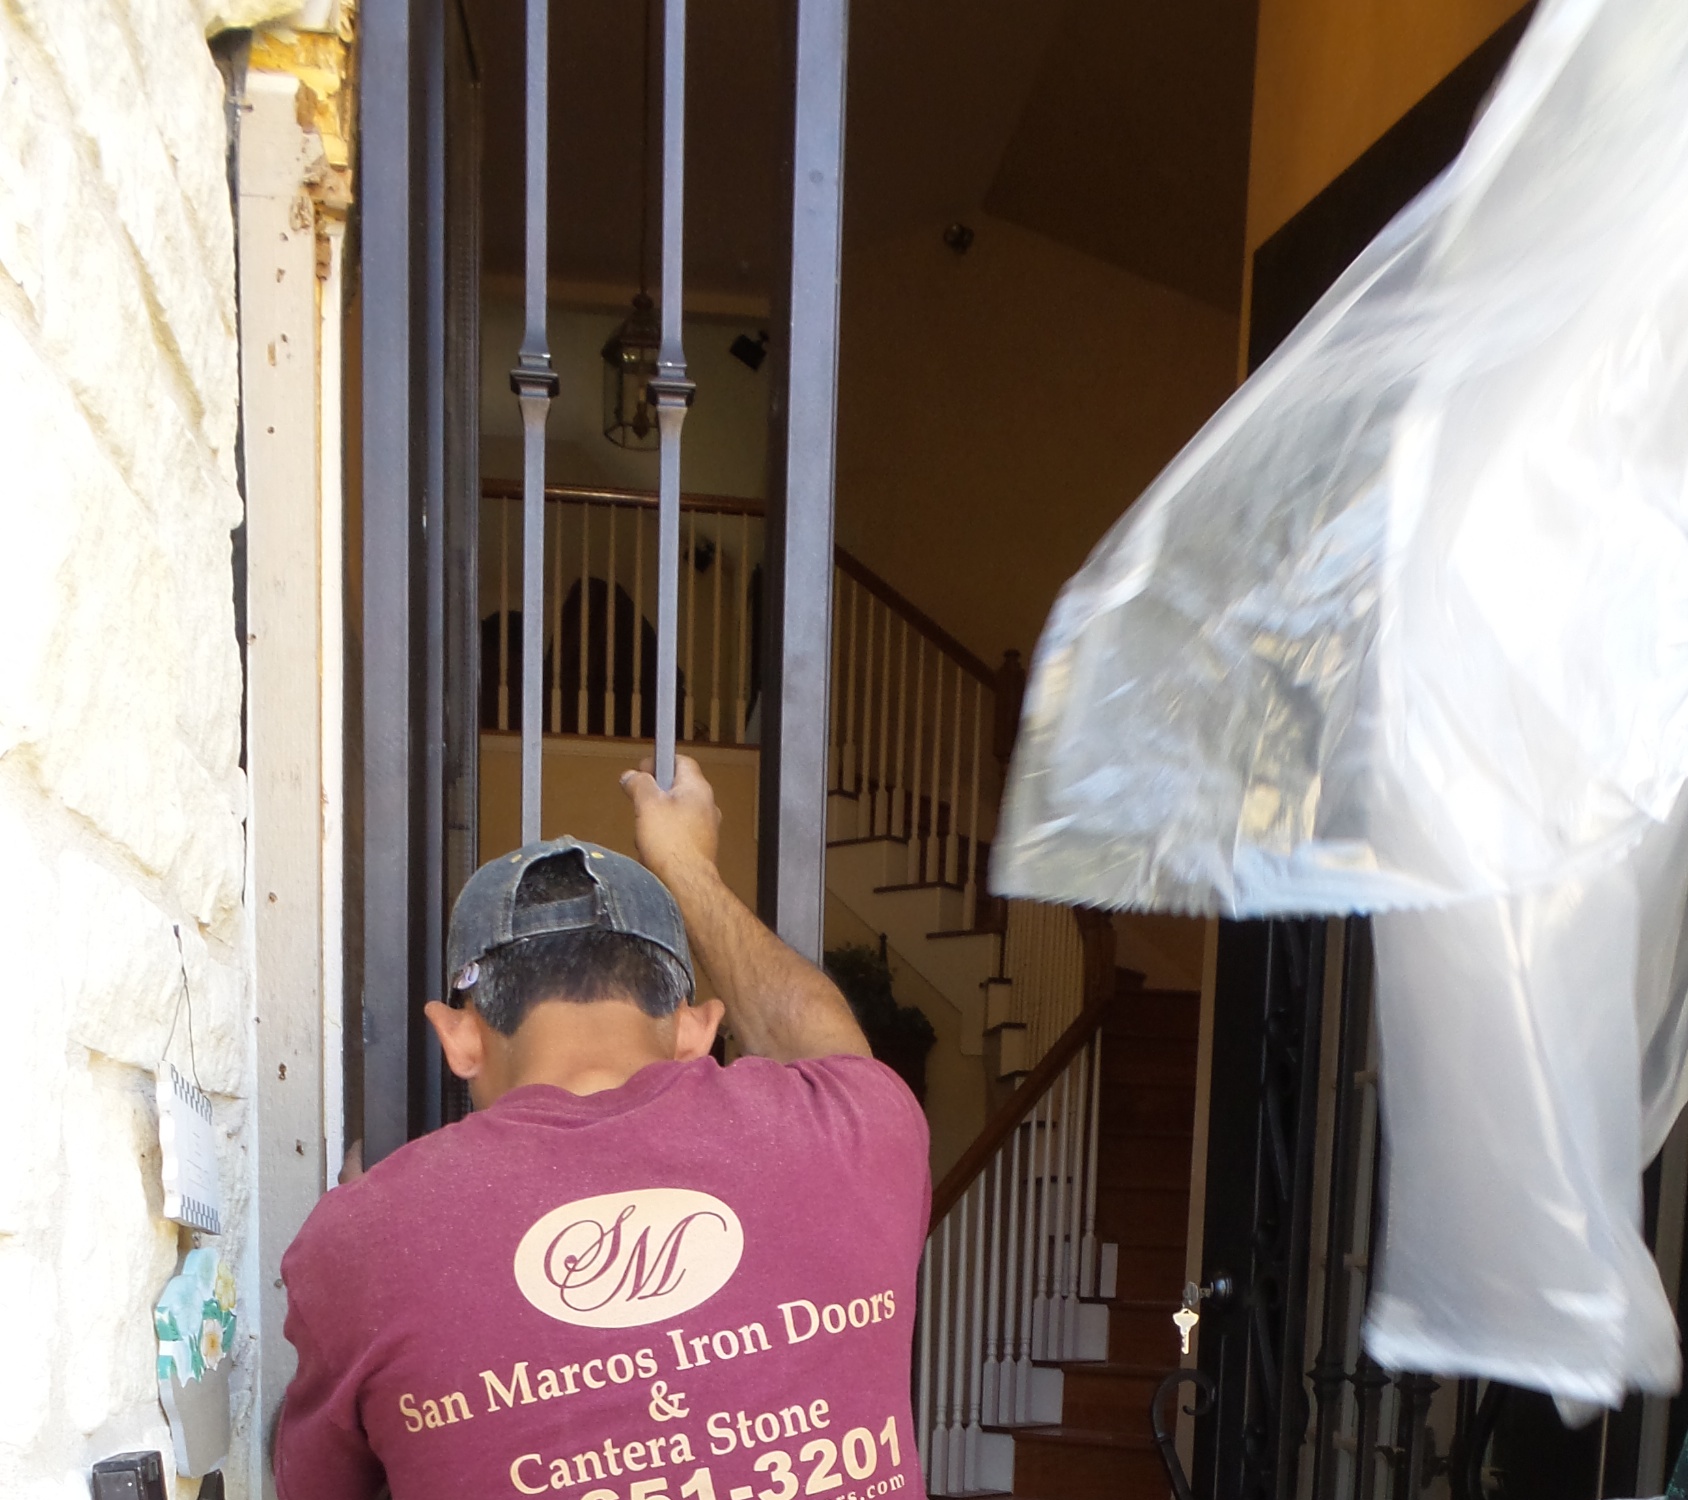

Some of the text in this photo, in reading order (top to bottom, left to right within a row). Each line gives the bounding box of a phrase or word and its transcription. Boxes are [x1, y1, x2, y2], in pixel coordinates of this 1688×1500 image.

[543, 1204, 727, 1312] SM
[399, 1289, 896, 1432] San Marcos Iron Doors
[648, 1380, 690, 1422] &
[509, 1398, 831, 1495] Cantera Stone
